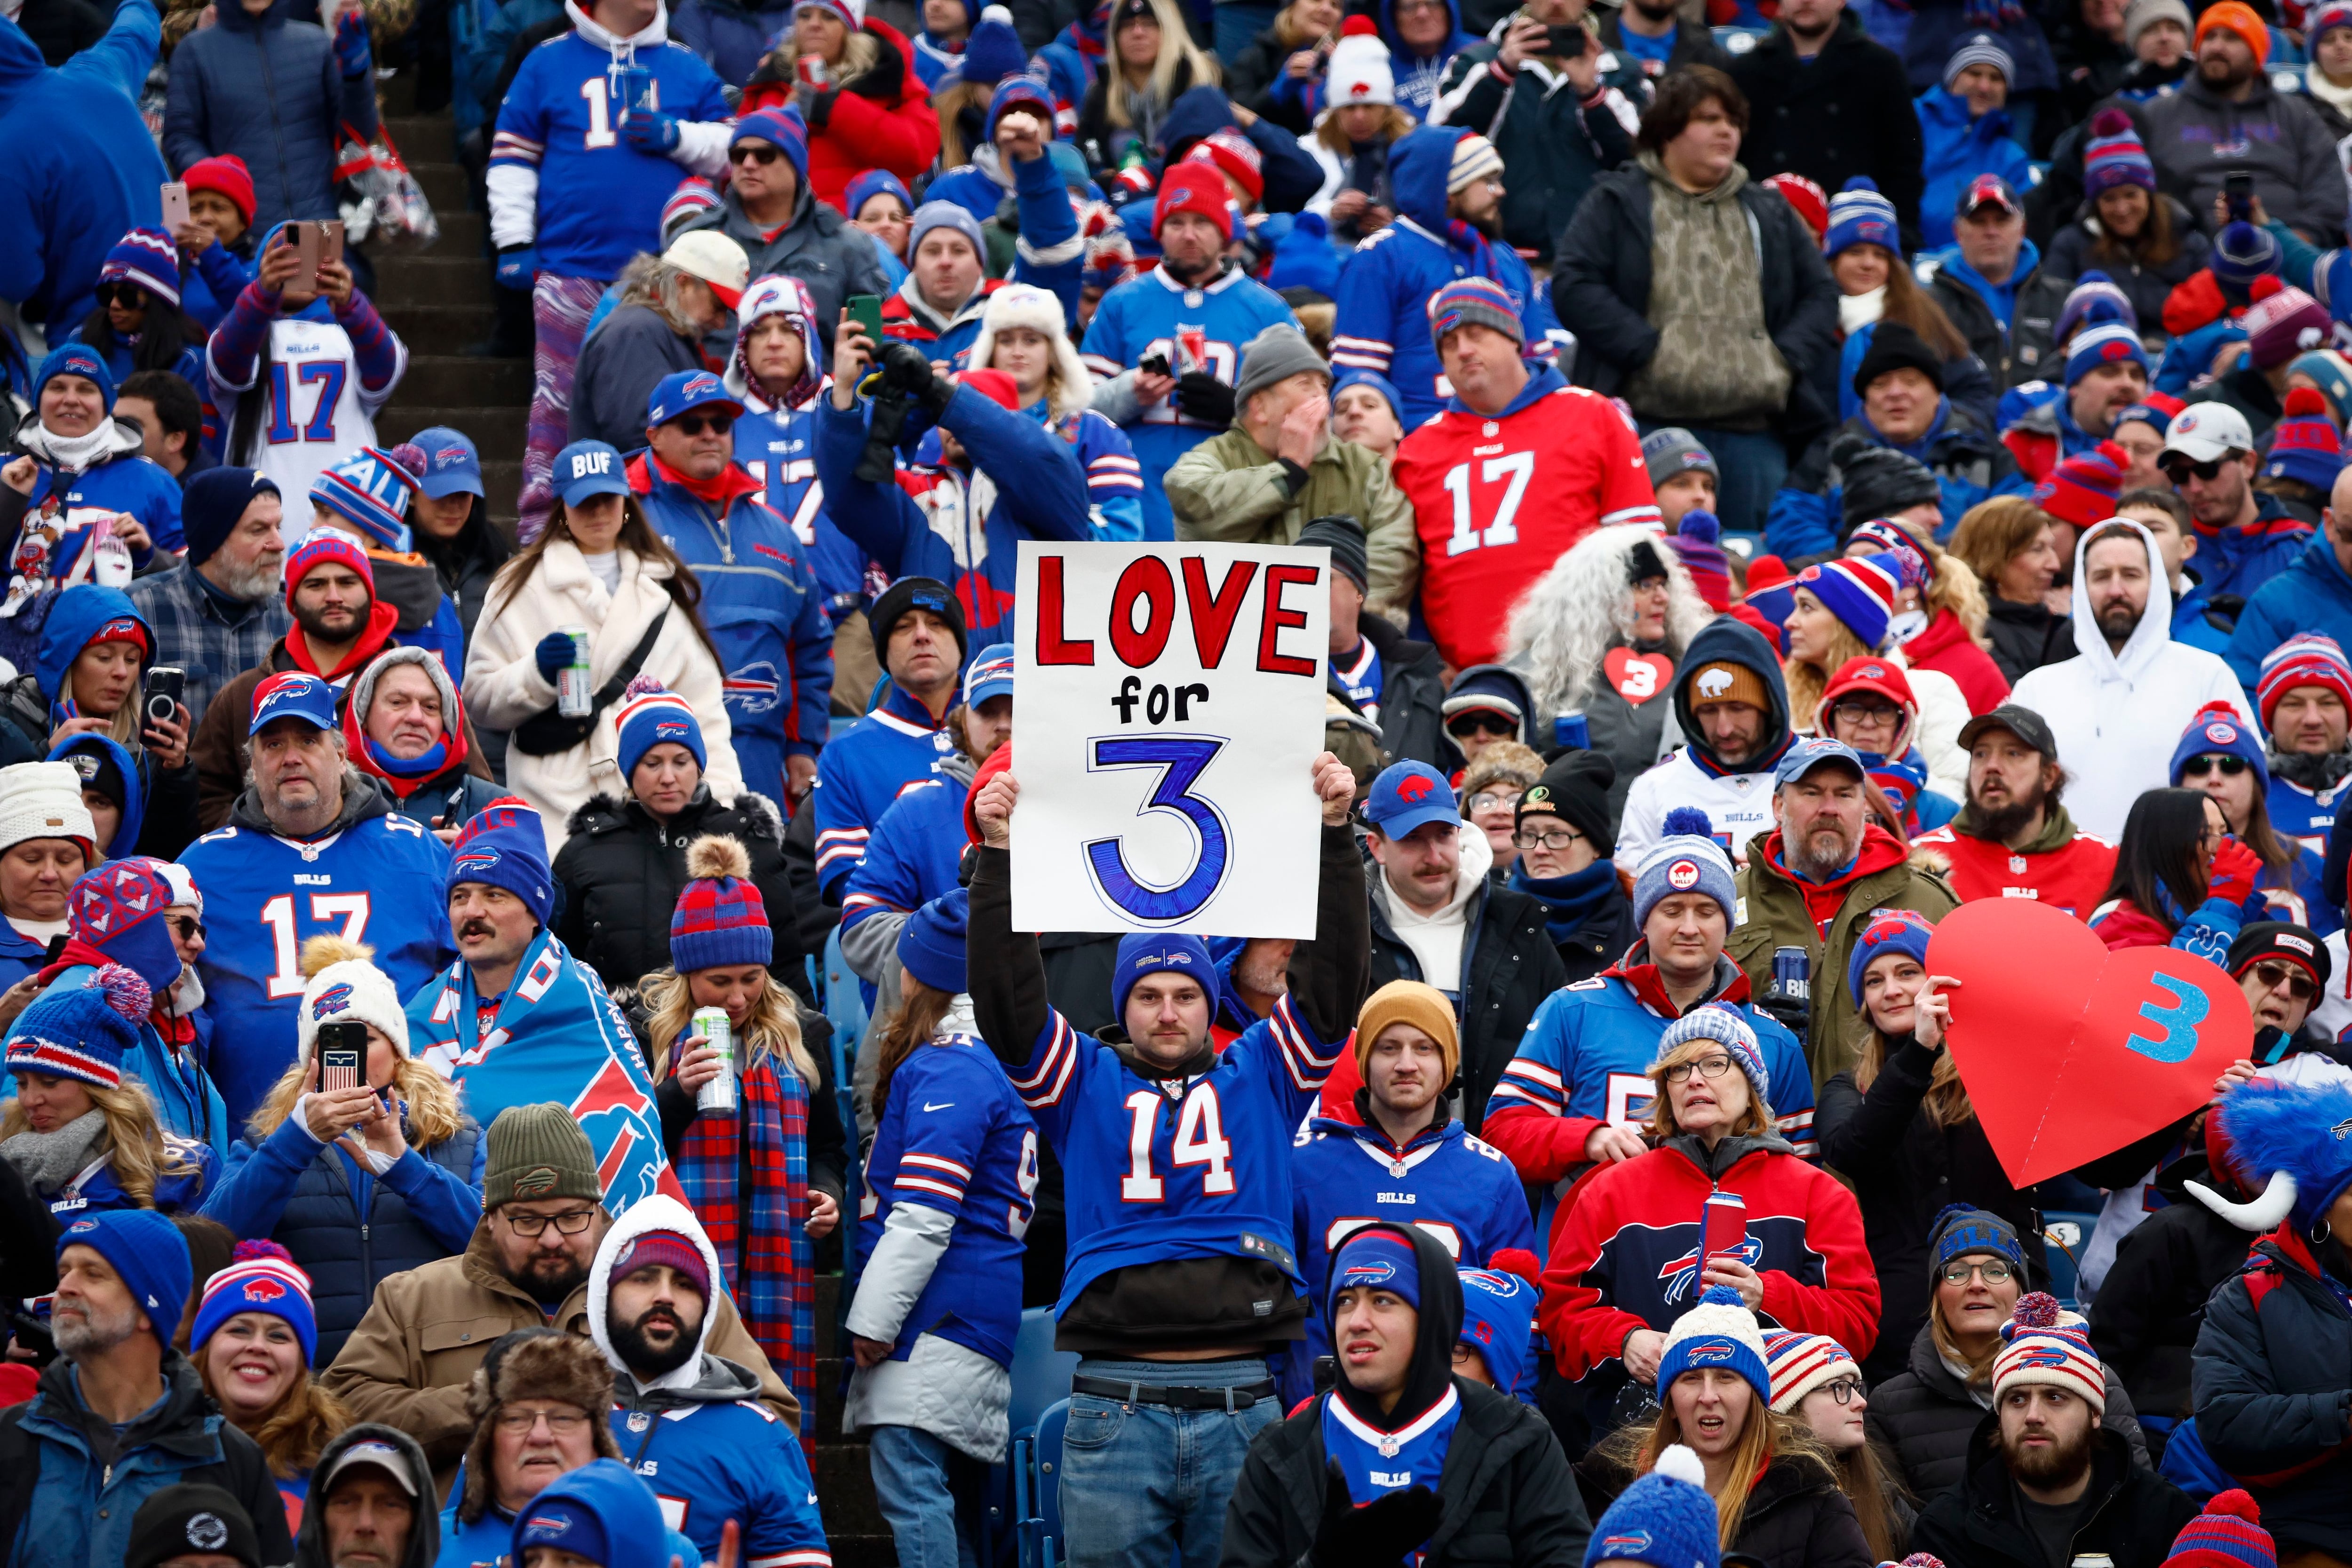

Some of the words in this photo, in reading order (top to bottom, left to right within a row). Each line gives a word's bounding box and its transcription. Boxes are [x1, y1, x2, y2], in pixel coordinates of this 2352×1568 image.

[267, 360, 346, 445] 17
[571, 452, 611, 479] BUF
[1445, 451, 1534, 557] 17
[1037, 555, 1320, 677] LOVE
[1620, 660, 1658, 697] 3
[1112, 676, 1209, 725] for
[454, 810, 517, 850] BILLS
[1083, 734, 1233, 927] 3
[1724, 813, 1763, 822] BILLS
[294, 874, 331, 886] BILLS
[2002, 887, 2038, 900] BILLS
[261, 891, 369, 999] 17
[1136, 958, 1163, 969] SPORTSBOOK
[605, 1002, 645, 1069] HAPPY
[2125, 971, 2210, 1064] 3
[1125, 1079, 1233, 1202] 14
[50, 1198, 88, 1214] BILLS
[1376, 1193, 1416, 1204] BILLS
[1939, 1226, 2022, 1265] BILLS
[2056, 1229, 2064, 1242] 5
[1369, 1472, 1411, 1488] BILLS
